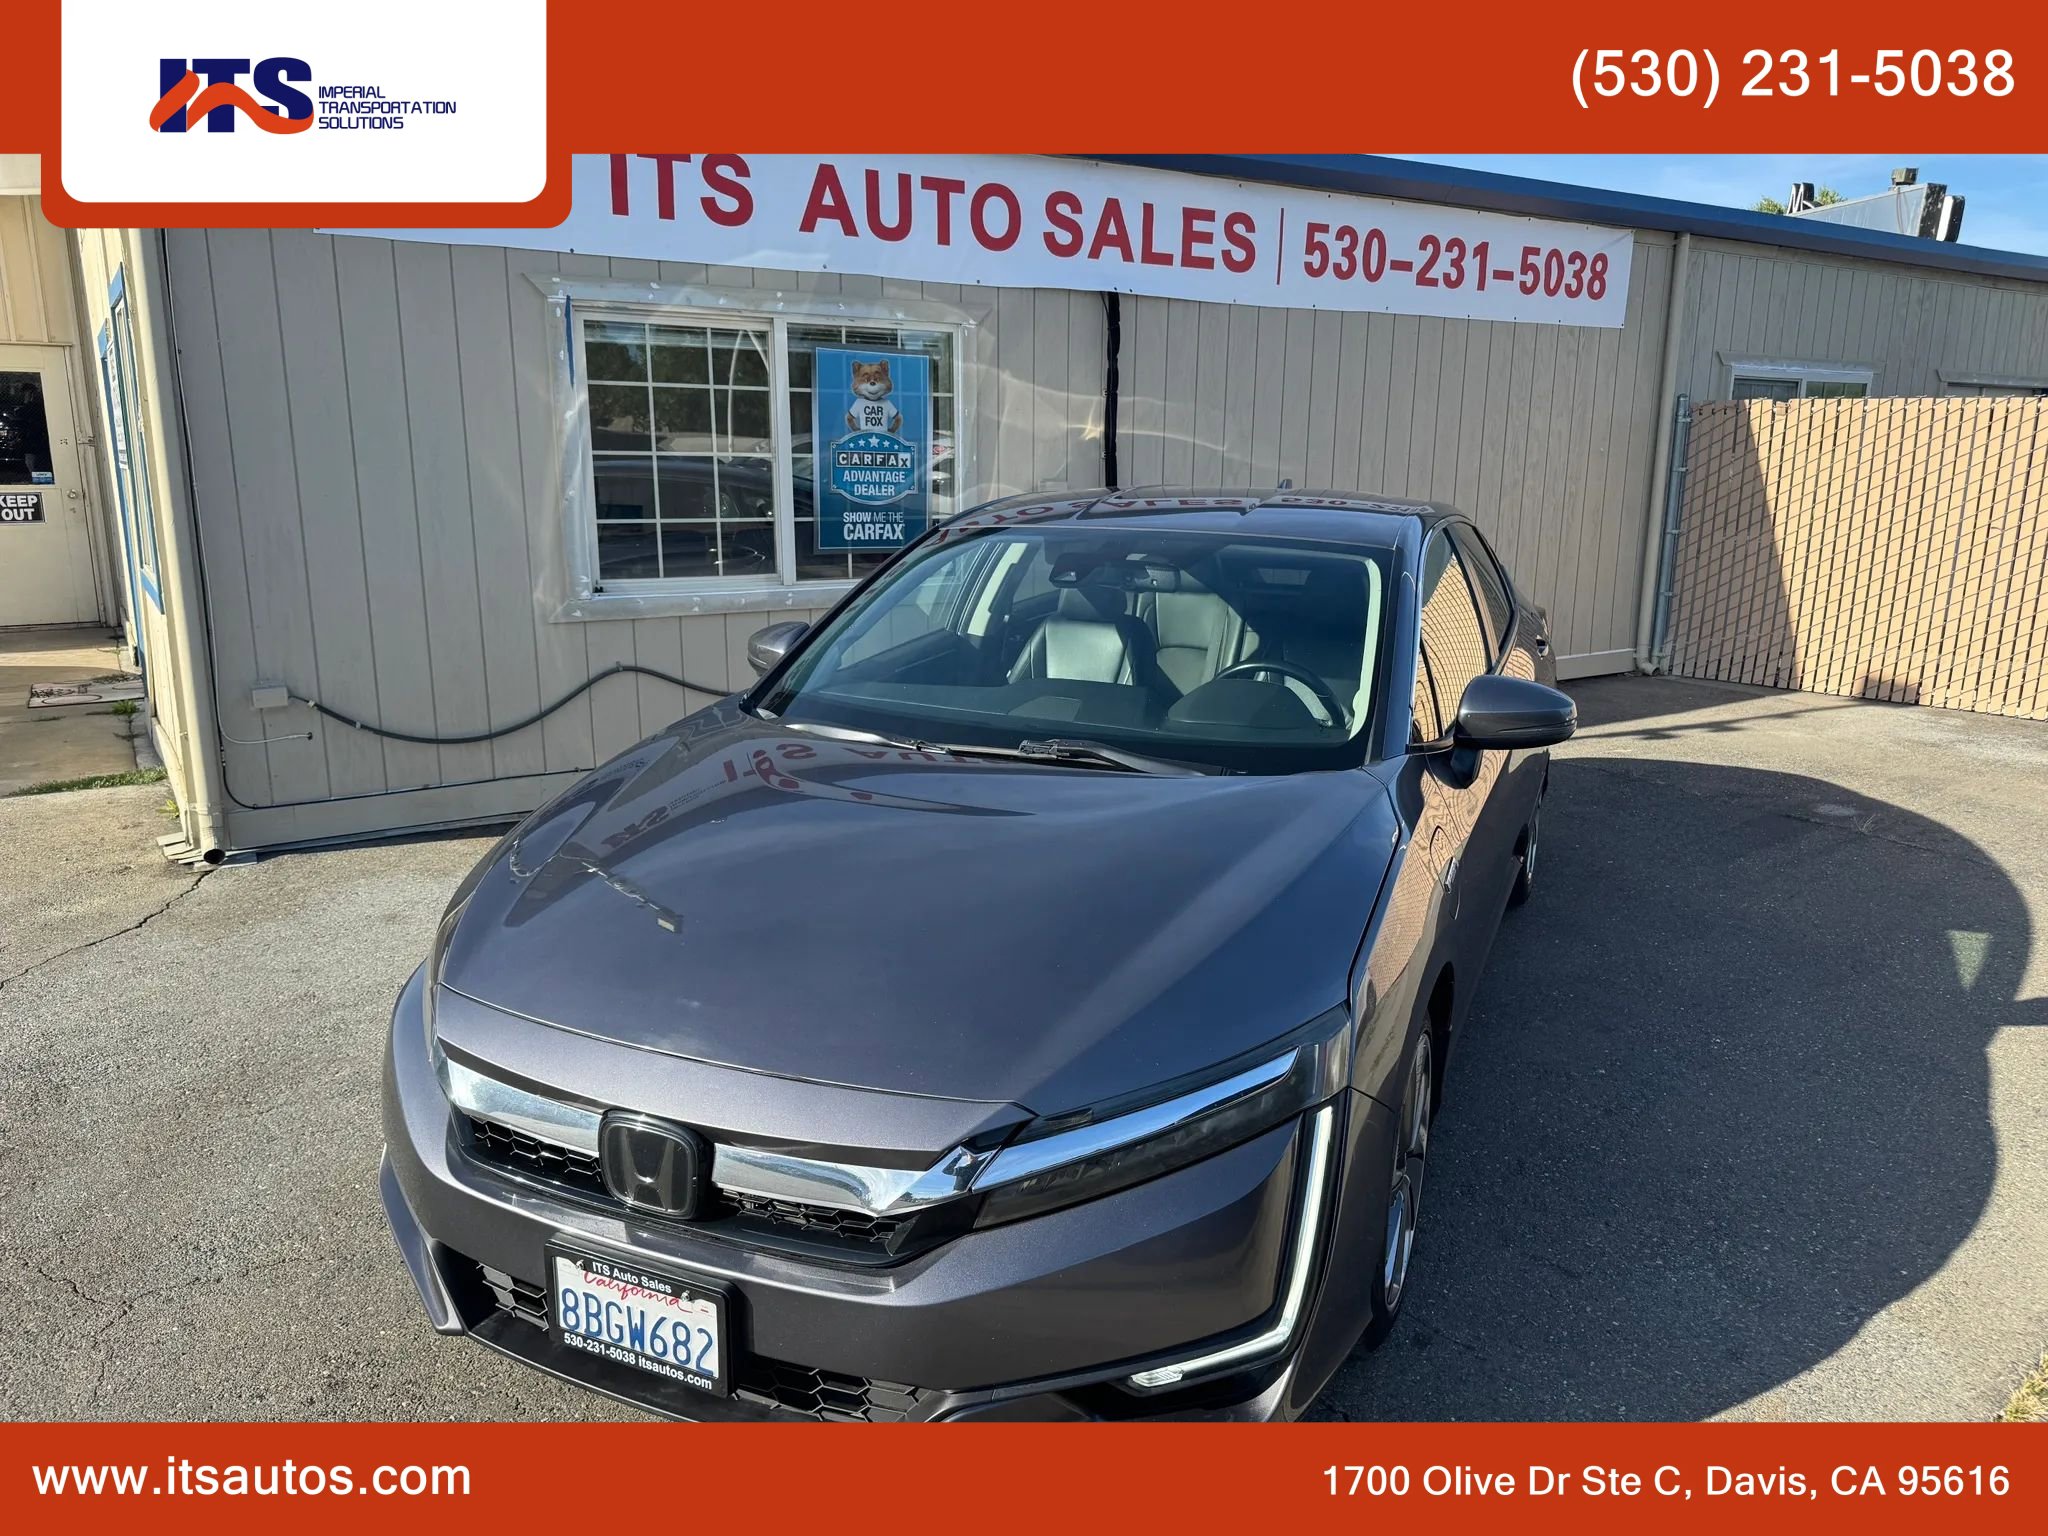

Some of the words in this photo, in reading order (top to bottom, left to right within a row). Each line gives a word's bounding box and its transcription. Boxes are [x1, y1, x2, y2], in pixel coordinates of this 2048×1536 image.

[609, 154, 754, 228] ITS
[798, 163, 1022, 252] AUTO
[1042, 190, 1257, 274] SALES
[1303, 221, 1609, 301] 530-231-5038
[863, 405, 884, 416] CAR
[864, 416, 884, 428] FOX
[842, 470, 906, 483] ADVANTAGE
[854, 484, 896, 496] DEALER
[1, 507, 35, 521] OUT
[843, 511, 872, 523] SHOW
[873, 511, 887, 523] ME
[888, 511, 904, 523] THE
[843, 523, 905, 540] CARFAX
[592, 1261, 611, 1276] ITS
[612, 1268, 639, 1284] Auto
[640, 1276, 672, 1294] Sales
[560, 1286, 715, 1377] 8BGW682
[564, 1331, 636, 1366] 530-231-5038
[637, 1354, 713, 1390] itsautos.com
